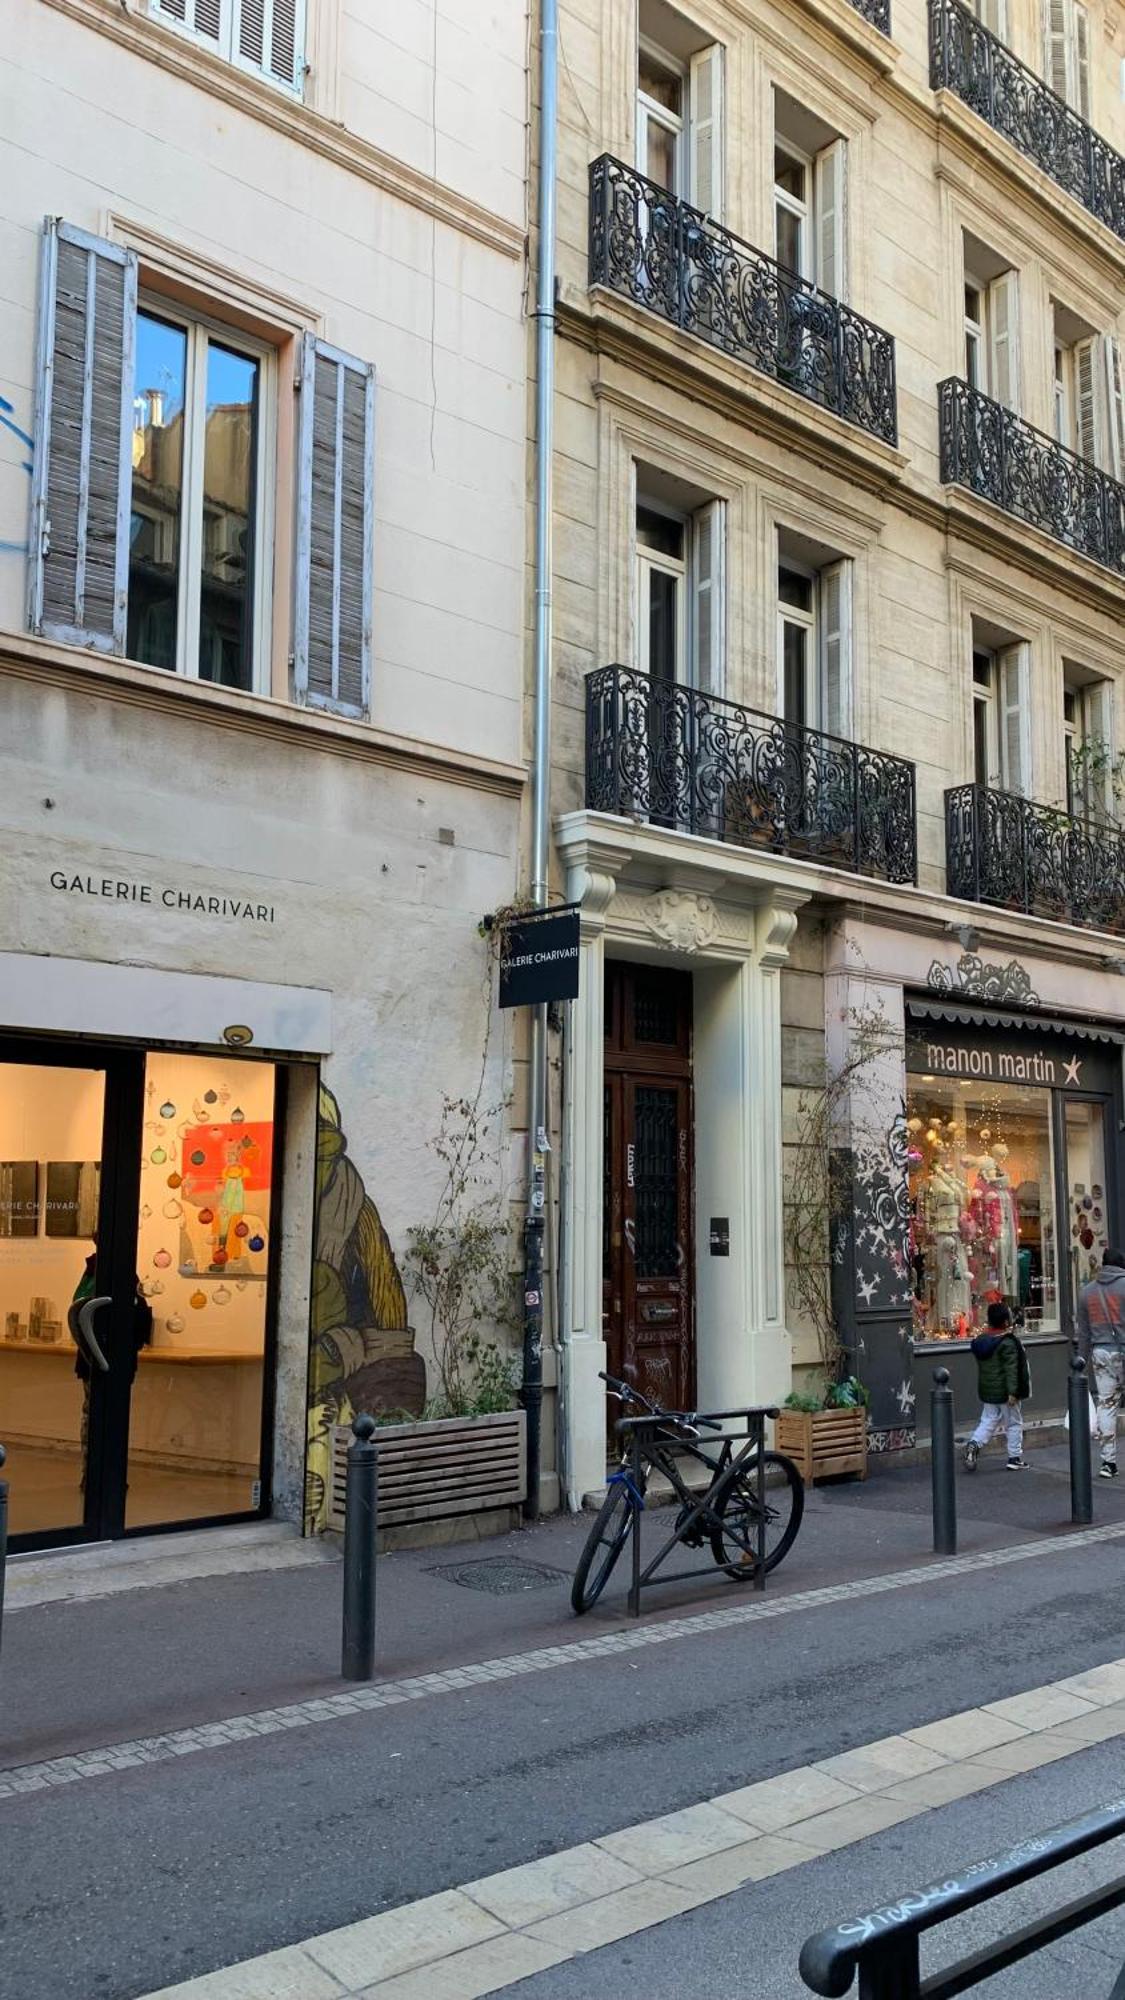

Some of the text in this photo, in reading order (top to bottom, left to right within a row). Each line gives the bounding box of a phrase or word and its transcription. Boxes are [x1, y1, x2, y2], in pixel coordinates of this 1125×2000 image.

[50, 871, 275, 923] GALERIE CHARIVARI
[534, 946, 578, 964] CHARIVARI
[927, 1044, 1056, 1082] manon martin
[26, 1201, 79, 1211] CHRIVAR
